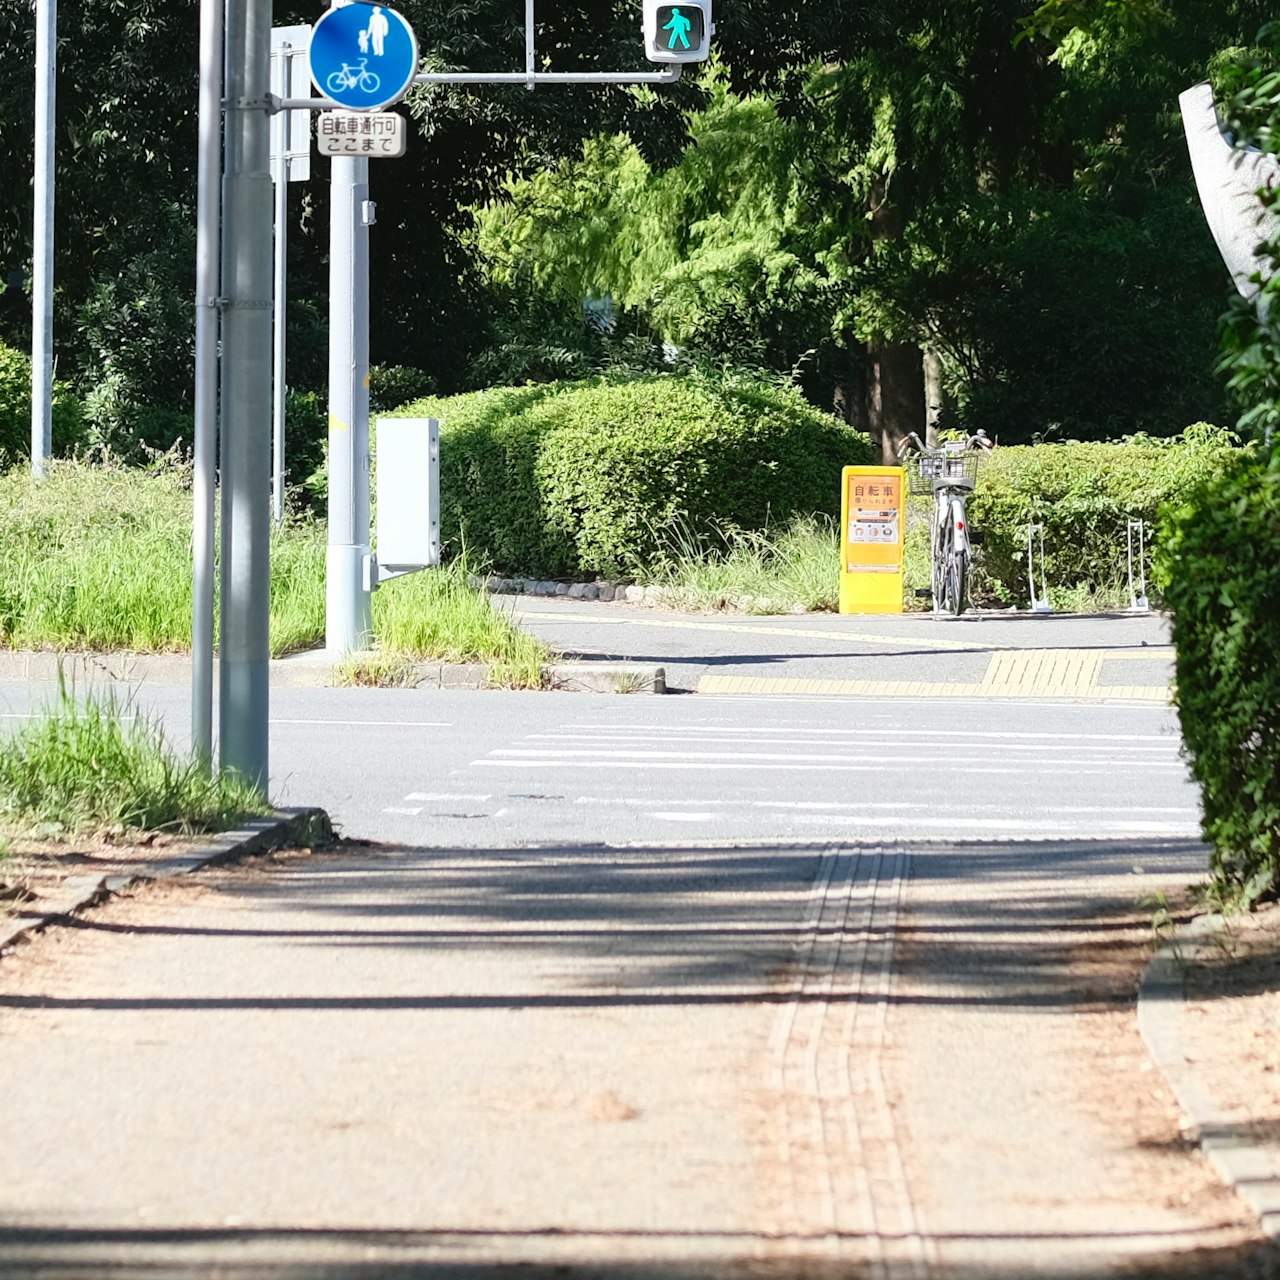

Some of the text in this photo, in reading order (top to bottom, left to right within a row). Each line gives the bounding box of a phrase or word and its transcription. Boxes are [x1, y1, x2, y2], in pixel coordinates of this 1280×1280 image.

[322, 117, 396, 136] 自転車通行可
[327, 137, 393, 152] ここまで
[855, 485, 894, 497] 自転車
